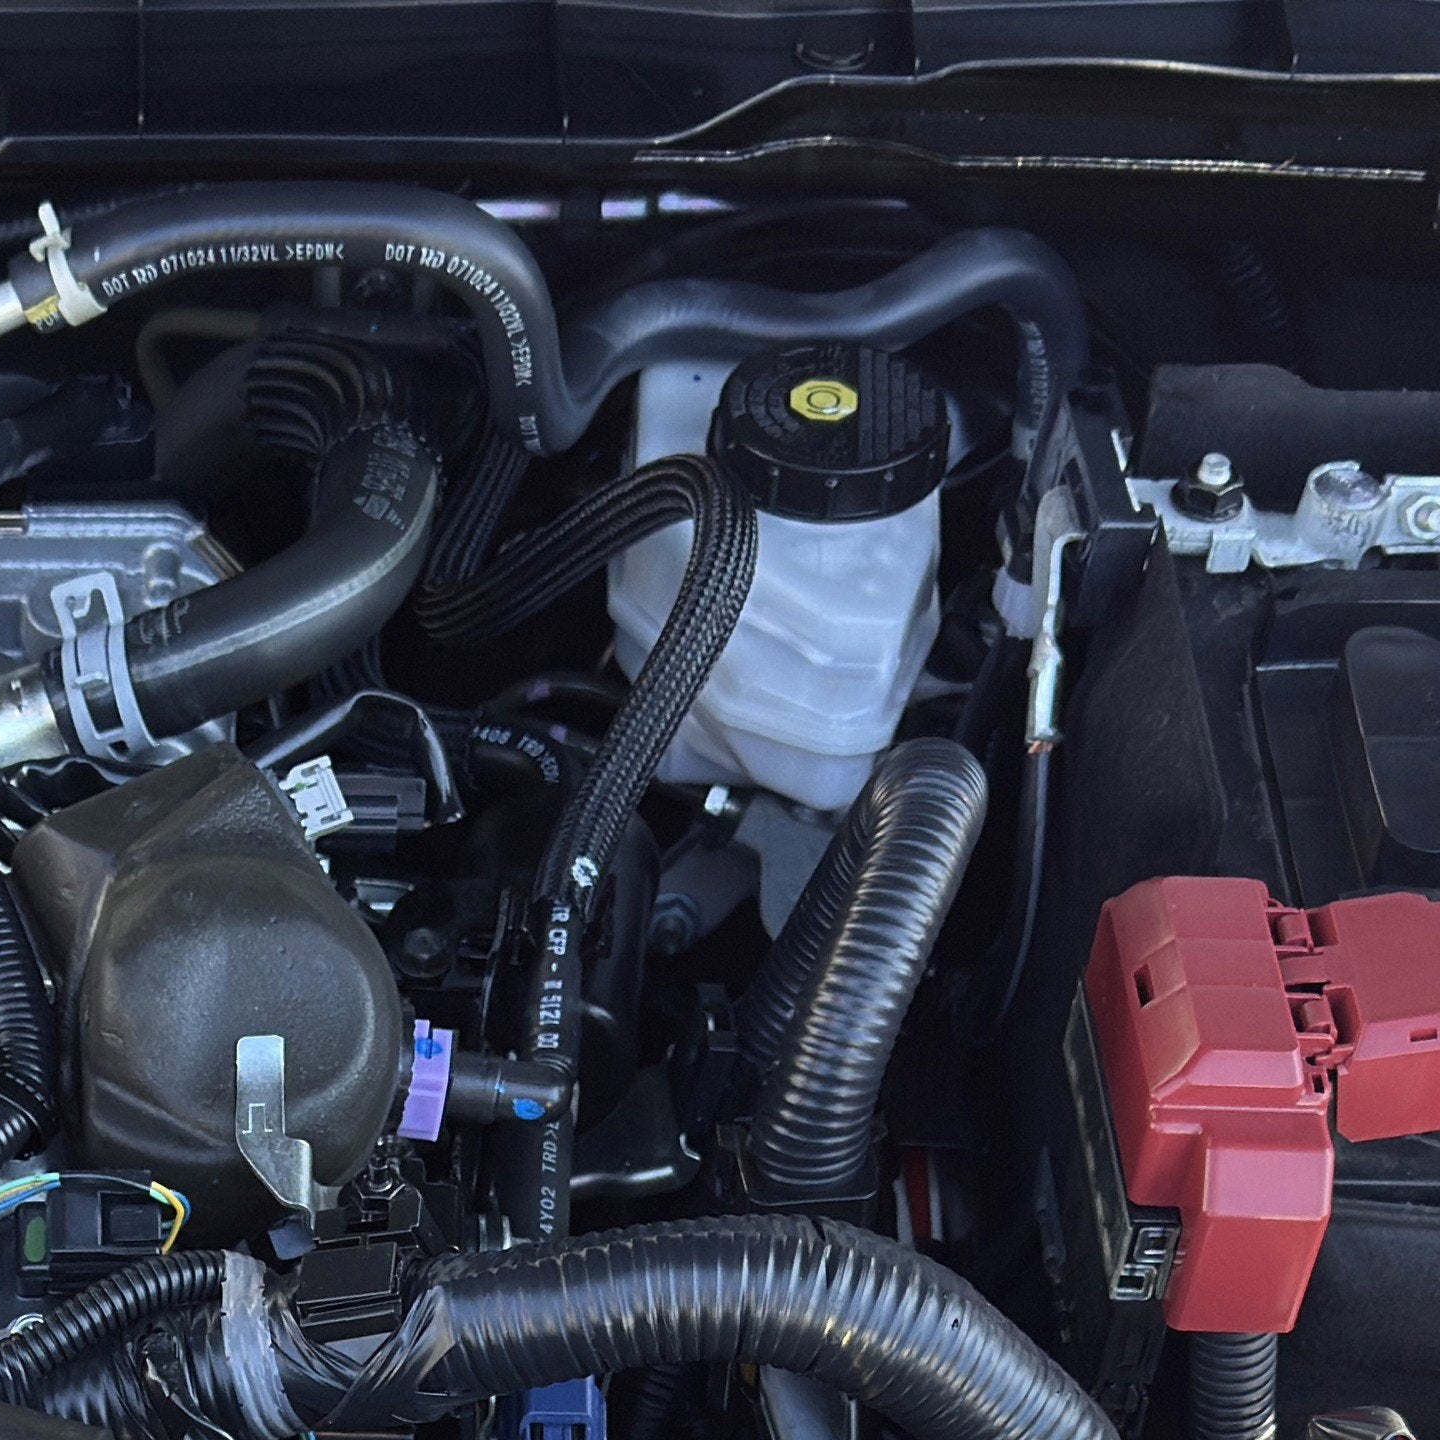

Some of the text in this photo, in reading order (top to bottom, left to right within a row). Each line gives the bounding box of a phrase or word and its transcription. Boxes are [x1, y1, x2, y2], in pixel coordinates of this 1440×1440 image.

[385, 243, 415, 263] DOT
[101, 273, 129, 297] DOT
[160, 247, 215, 275] 071024
